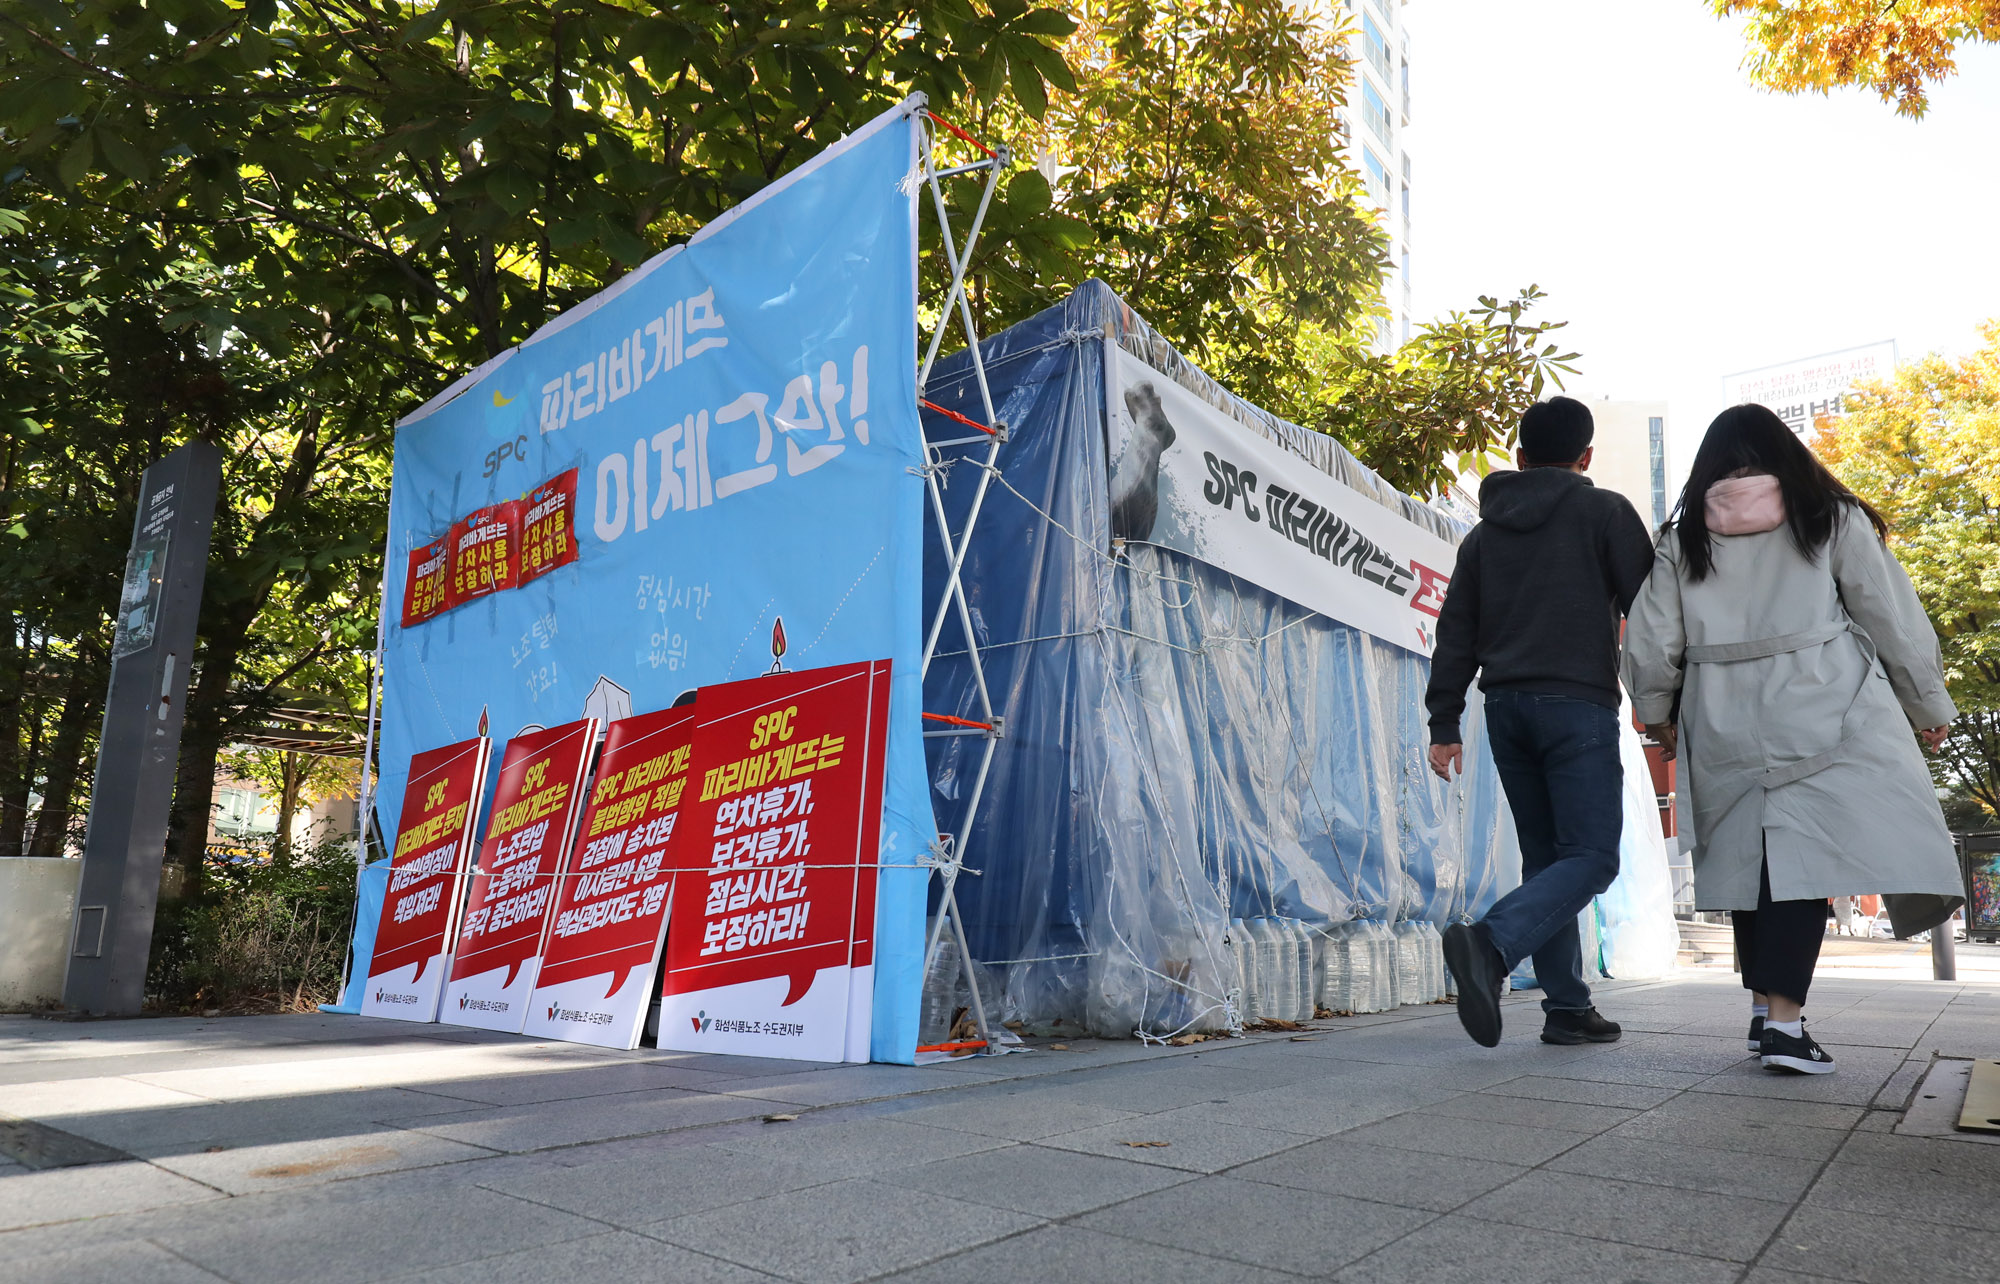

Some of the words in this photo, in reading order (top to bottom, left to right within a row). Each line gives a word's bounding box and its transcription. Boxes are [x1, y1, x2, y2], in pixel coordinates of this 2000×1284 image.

[483, 435, 527, 478] SPC
[458, 522, 507, 553] 파리바게뜨는
[478, 516, 489, 525] SPC
[1203, 451, 1260, 522] SPC
[1265, 483, 1415, 597] 파리바게뜨는
[636, 574, 711, 621] 점심시간
[750, 705, 798, 750] SPC
[521, 758, 550, 796] SPC
[592, 771, 624, 806] SPC
[699, 733, 845, 803] 파리바게뜨는
[424, 778, 448, 812] SPC
[442, 801, 468, 837] 문제
[488, 781, 569, 840] 파리바게뜨는
[588, 790, 651, 837] 불법행위
[651, 776, 687, 812] 적발
[713, 778, 815, 837] 연차휴가,
[492, 819, 549, 869] 노조탄압
[580, 829, 629, 870] 검찰에
[625, 811, 678, 855] 송치된
[707, 819, 811, 876] 보건휴가,
[462, 905, 492, 940] 즉각
[488, 883, 551, 933] 중단하라!
[554, 890, 641, 938] 핵심관리자도
[636, 882, 668, 918] 3명
[705, 861, 807, 917] 점심시간,
[699, 900, 811, 957] 보장하라!
[714, 1019, 761, 1035] 화섬식품노조
[762, 1021, 804, 1037] 수도권지부
